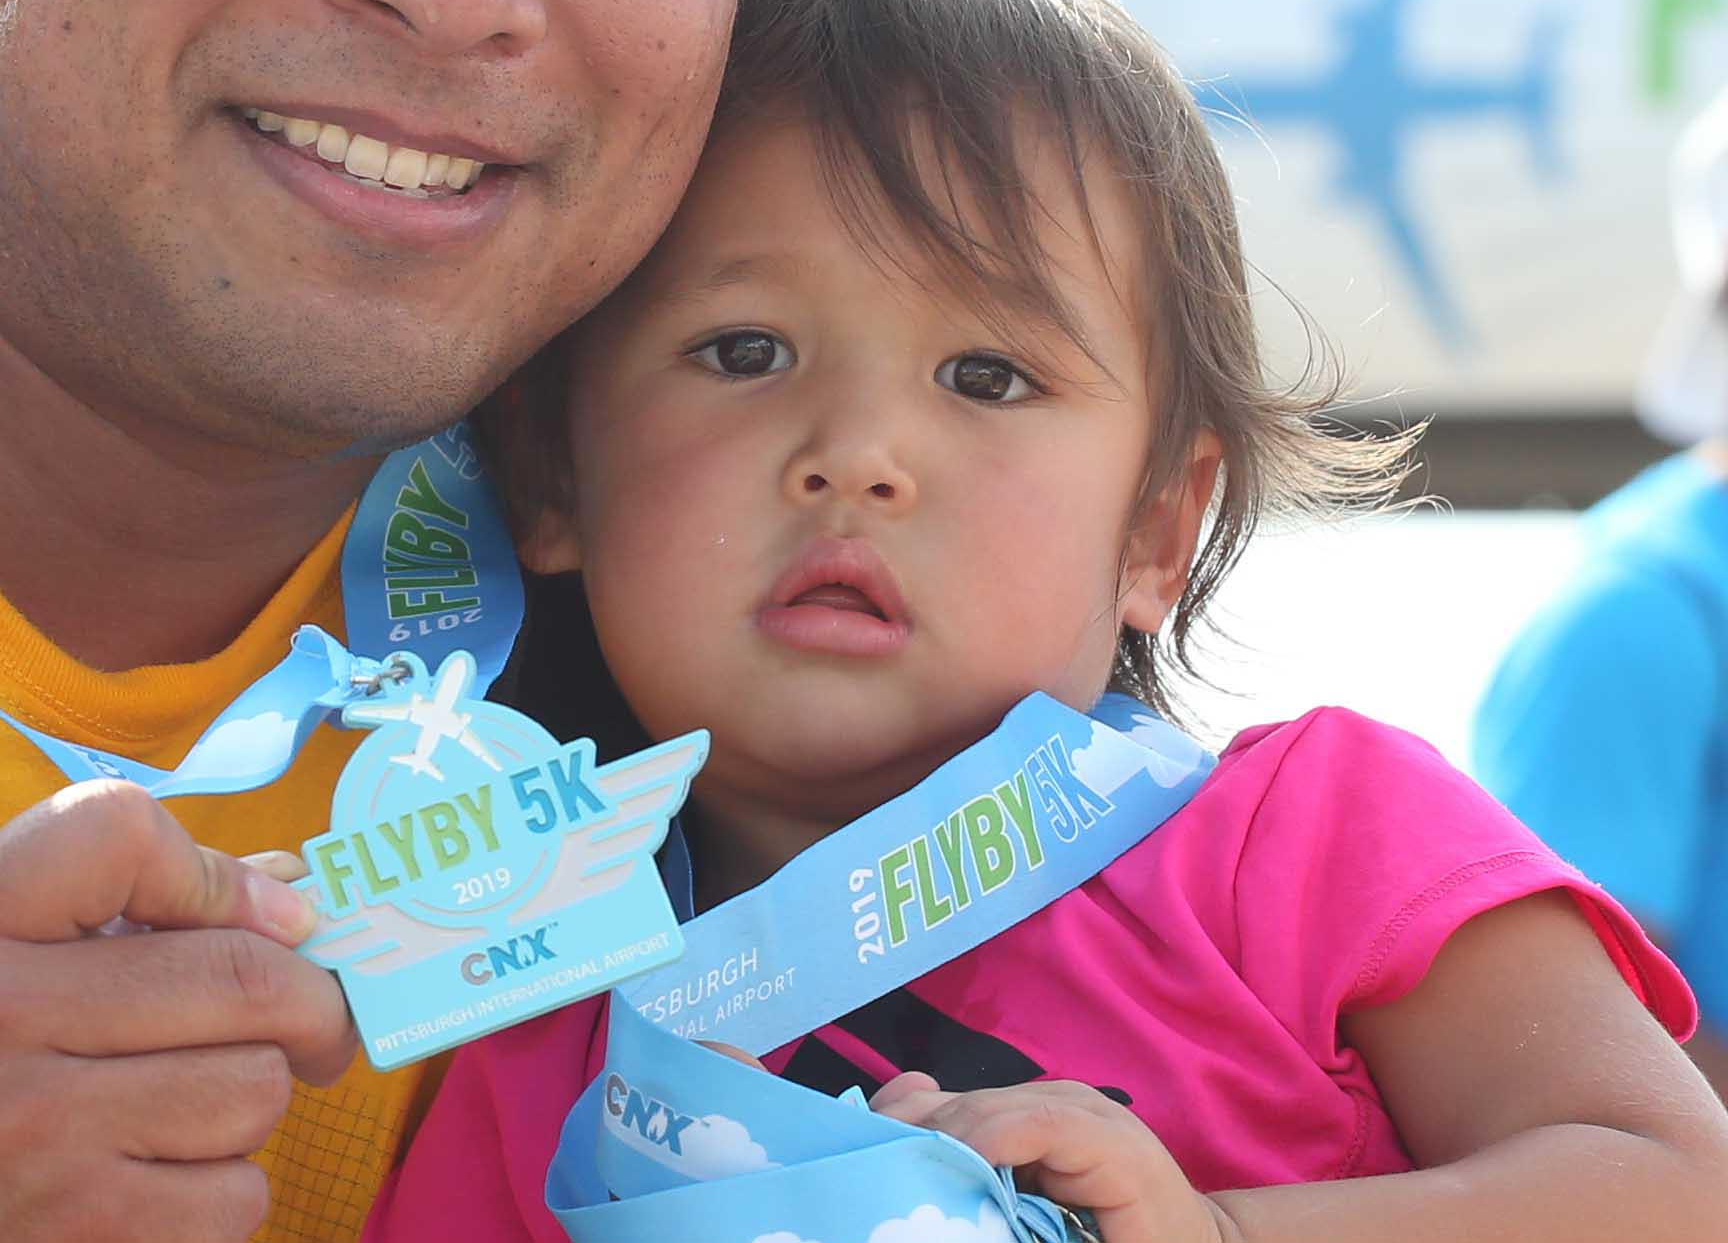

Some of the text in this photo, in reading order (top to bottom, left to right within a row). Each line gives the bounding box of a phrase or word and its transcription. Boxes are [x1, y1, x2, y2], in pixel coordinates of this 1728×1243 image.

[383, 455, 481, 620] FLYBY
[389, 607, 483, 643] 2019
[313, 749, 608, 910] FLYBY 5K
[879, 732, 1117, 949] FLYBY 5K
[451, 867, 513, 906] 2019
[847, 867, 886, 965] 2019
[374, 931, 671, 1054] PITTSBURGH INTERNATIONAL AIRPORT
[714, 966, 797, 1026] AIRPORT
